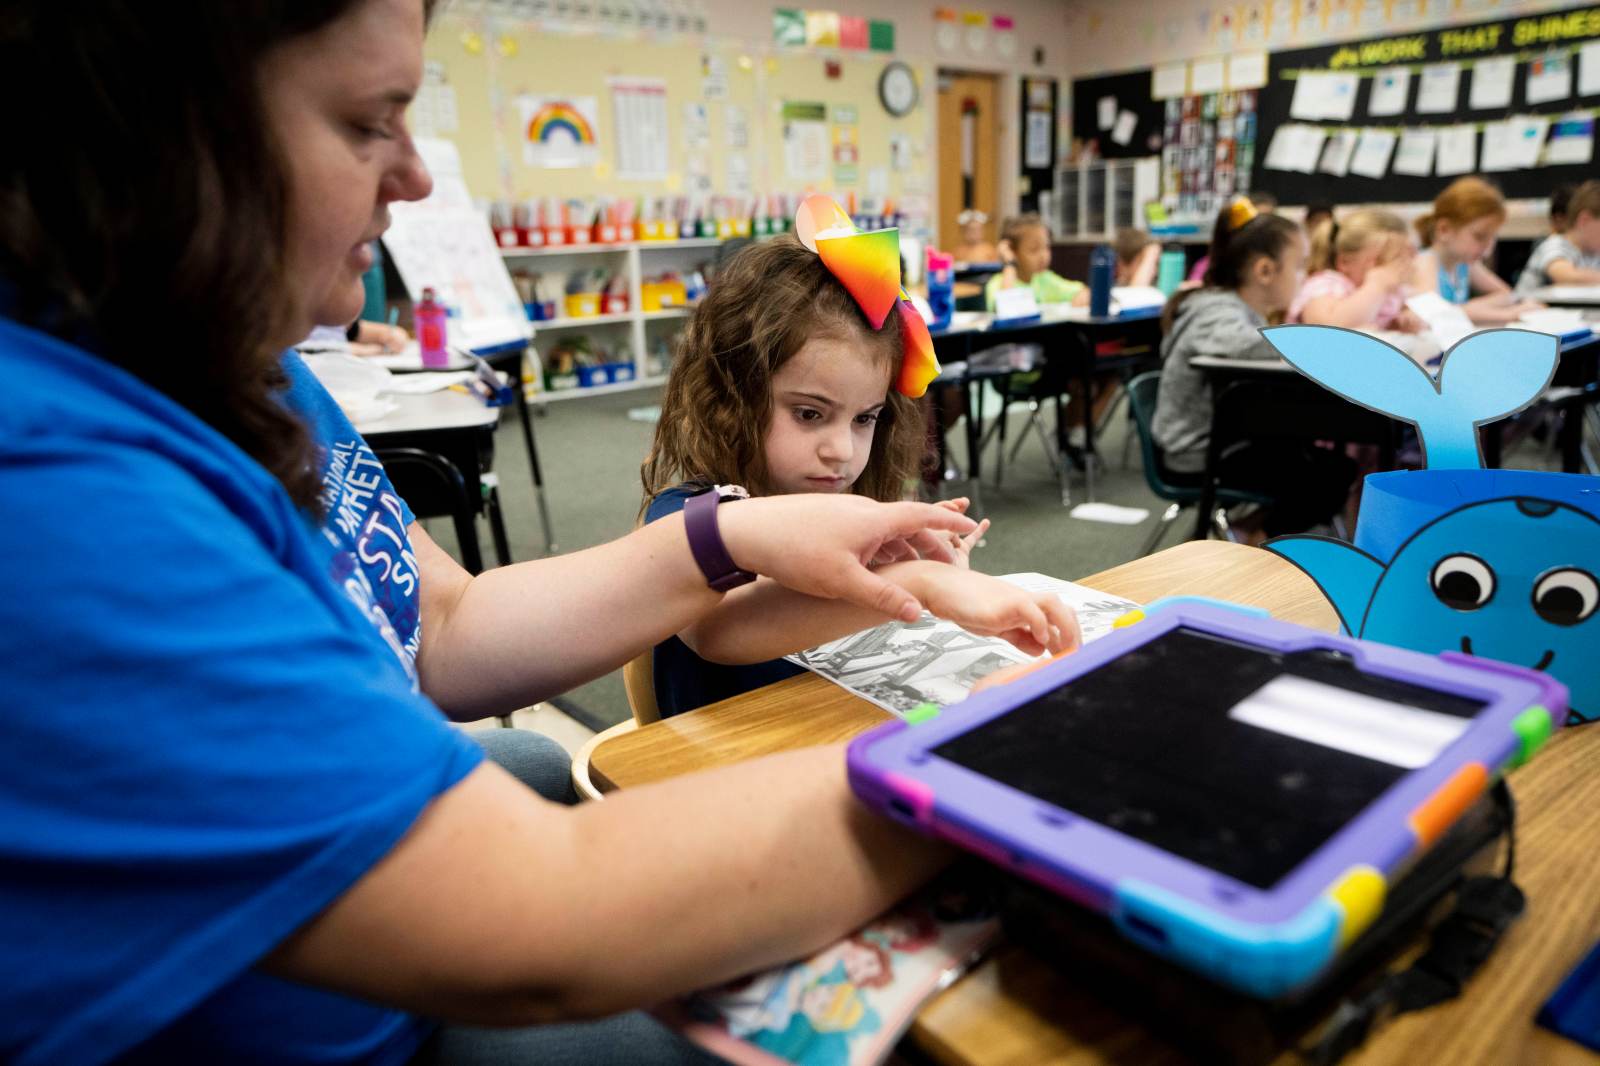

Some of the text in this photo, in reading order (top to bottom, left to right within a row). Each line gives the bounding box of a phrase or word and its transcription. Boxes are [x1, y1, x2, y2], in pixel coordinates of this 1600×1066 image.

[1359, 9, 1600, 64] WORK THAT SHINES
